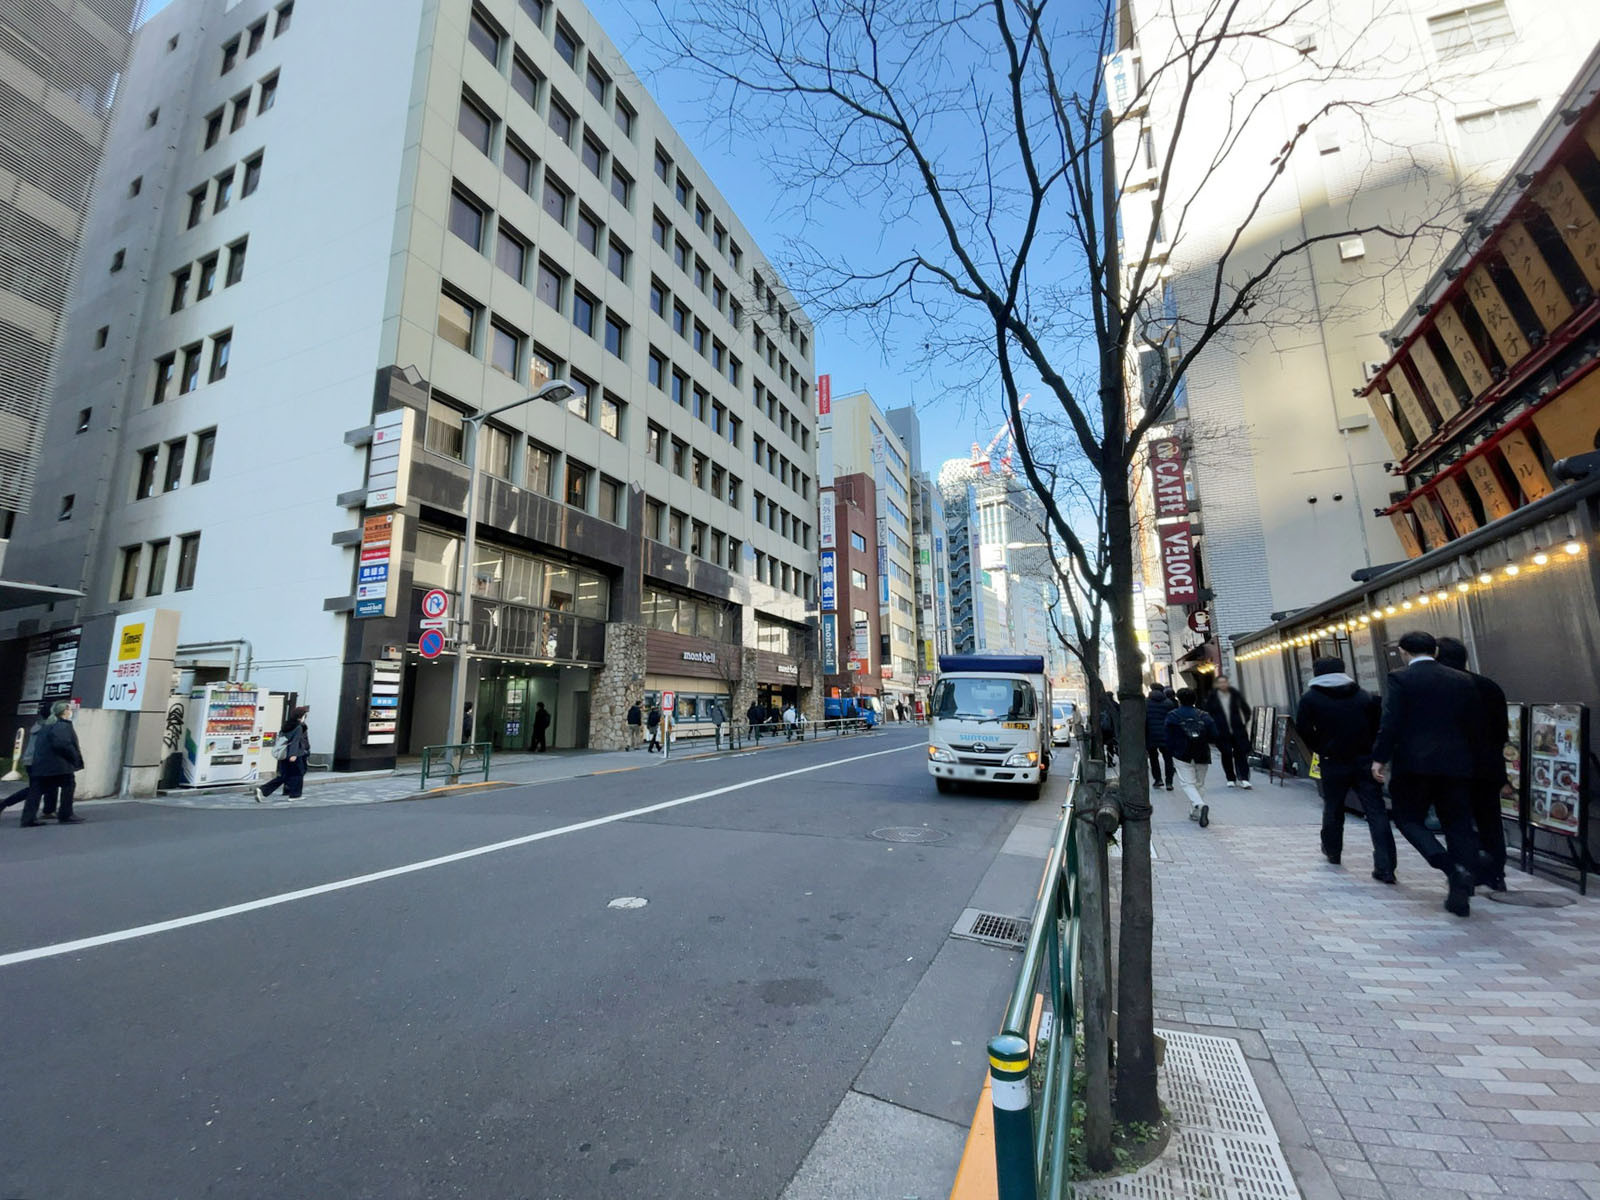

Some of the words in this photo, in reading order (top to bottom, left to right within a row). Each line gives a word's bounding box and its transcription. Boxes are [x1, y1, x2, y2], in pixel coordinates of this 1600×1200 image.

[1468, 270, 1523, 362] 水餃子
[1165, 530, 1194, 596] VELOCE
[109, 683, 128, 701] OUT
[960, 734, 1000, 743] SUNTORY
